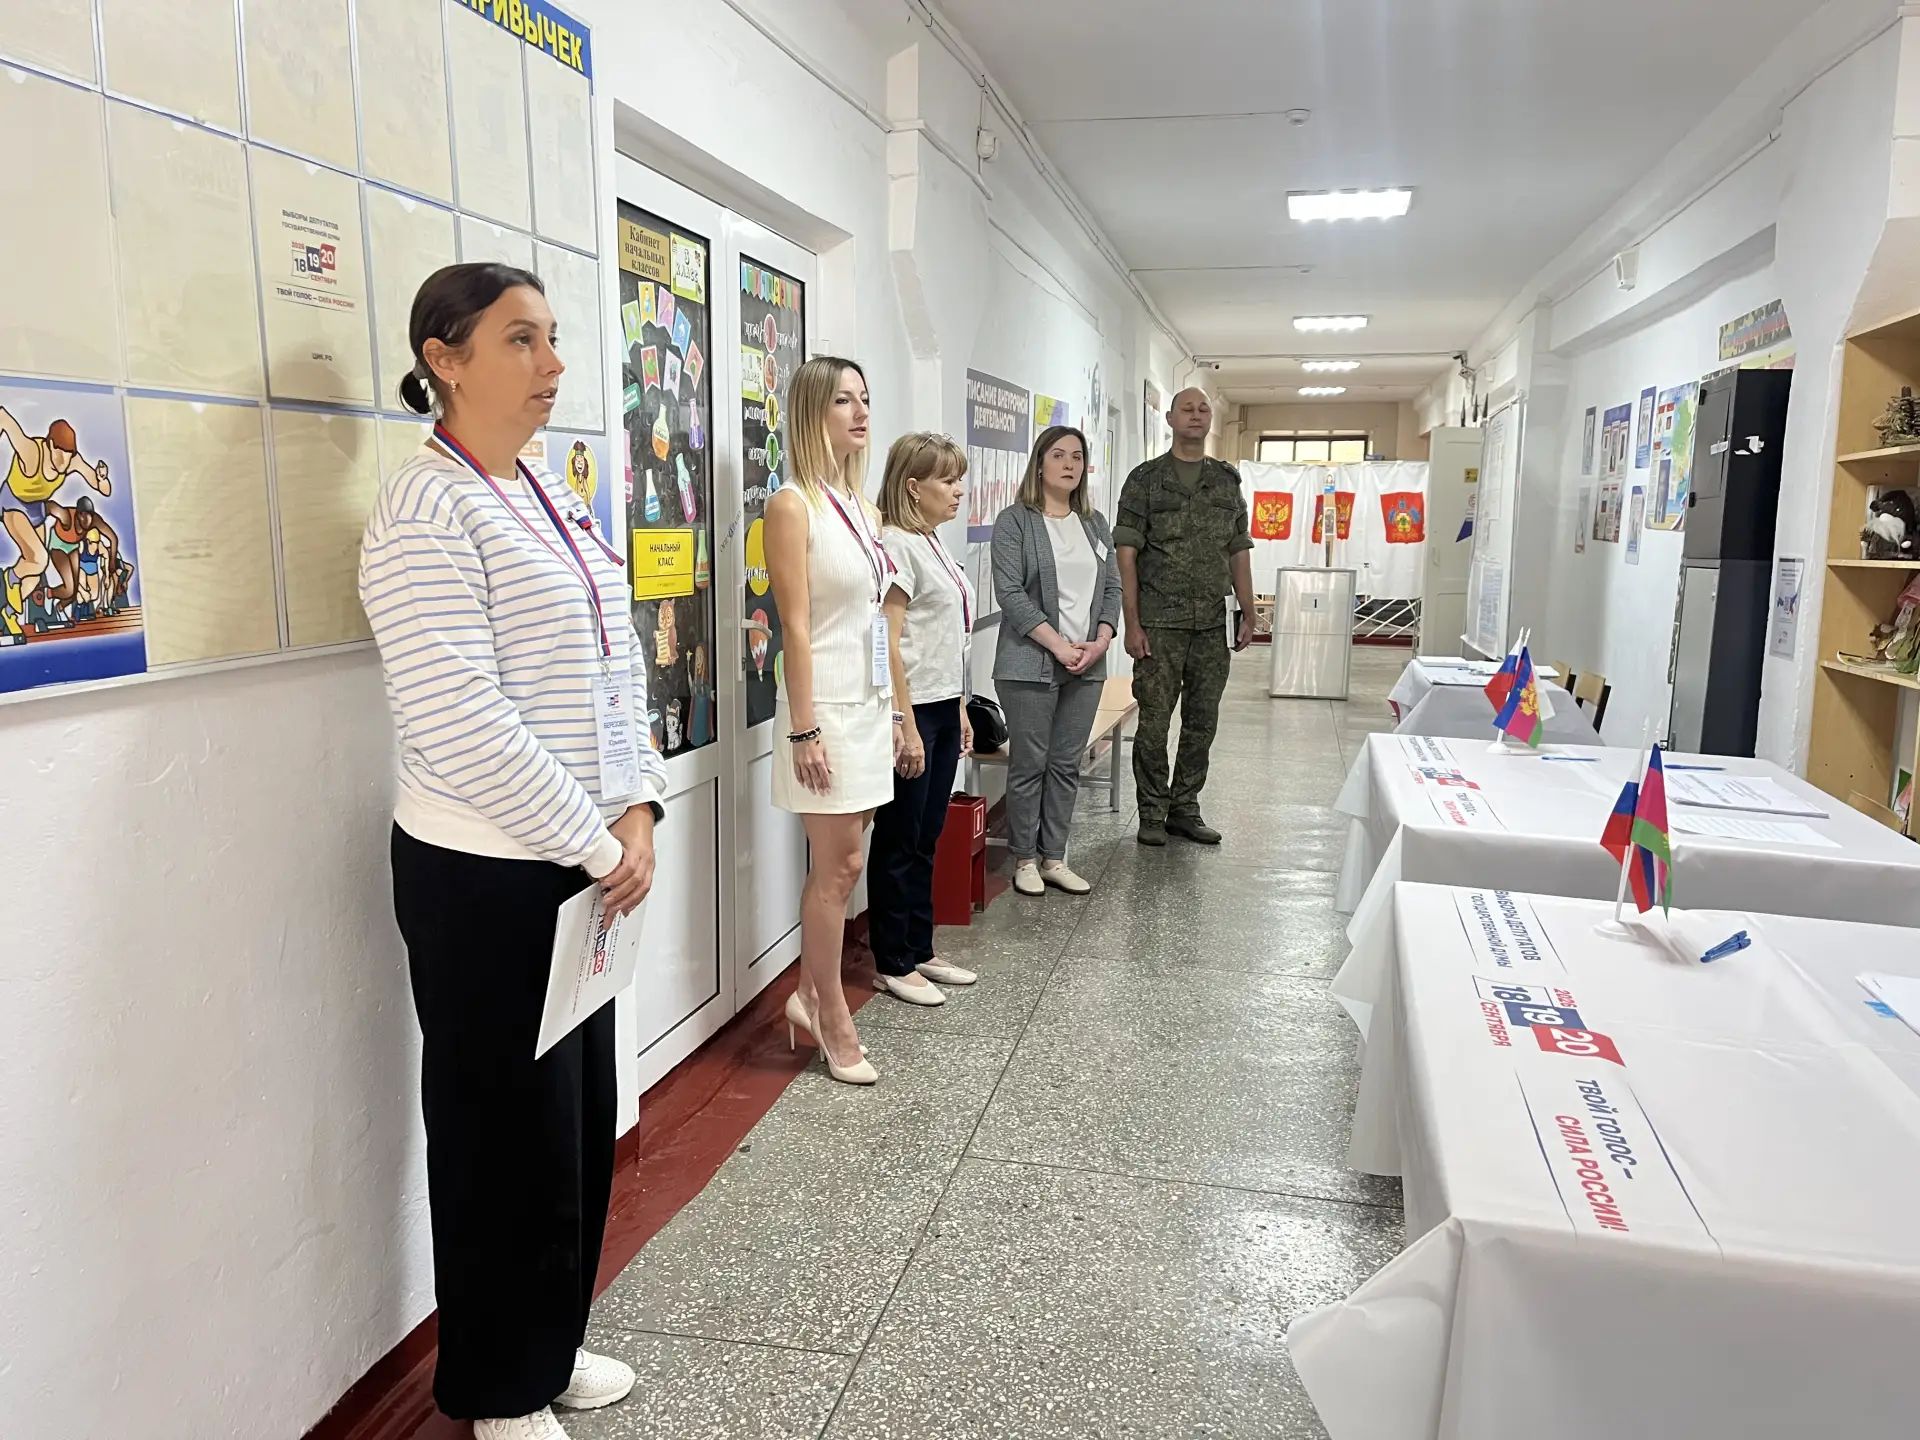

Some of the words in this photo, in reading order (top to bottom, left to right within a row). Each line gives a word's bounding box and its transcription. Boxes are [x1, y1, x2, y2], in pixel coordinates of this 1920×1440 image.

[282, 209, 308, 221] ВЫБОРЫ
[308, 216, 339, 230] ДЕПУТАТОВ
[630, 225, 660, 250] Кабинет
[294, 258, 307, 273] 18
[307, 252, 320, 268] 19
[320, 249, 334, 265] 20
[624, 242, 666, 266] начальных
[310, 274, 337, 285] СЕНТЯБРЯ
[631, 260, 660, 278] классов
[276, 287, 292, 297] ТВОЙ
[293, 290, 313, 301] ГОЛОС
[318, 296, 333, 304] СИЛА
[973, 405, 1016, 433] ДЕЯТЕЛЬНОСТИ
[649, 541, 681, 553] НАЧАЛЬНЫЙ
[657, 557, 674, 567] КЛАСС
[1493, 889, 1520, 919] ВЫБОРЫ
[1469, 892, 1507, 947] ГОСУДАРСТВЕННОЙ
[1488, 946, 1513, 968] ДУМЫ
[1503, 918, 1541, 960] ДЕПУТАТОВ
[1480, 1001, 1512, 1047] СЕНТЯБРЯ
[1491, 985, 1532, 1002] 18
[1521, 1006, 1564, 1025] 19
[1550, 1027, 1600, 1055] 20
[1575, 1079, 1619, 1114] ТВОЙ
[1555, 1115, 1593, 1154] СИЛА
[1591, 1115, 1638, 1166] ГОЛОС
[1571, 1157, 1630, 1232] РОССИИ!
